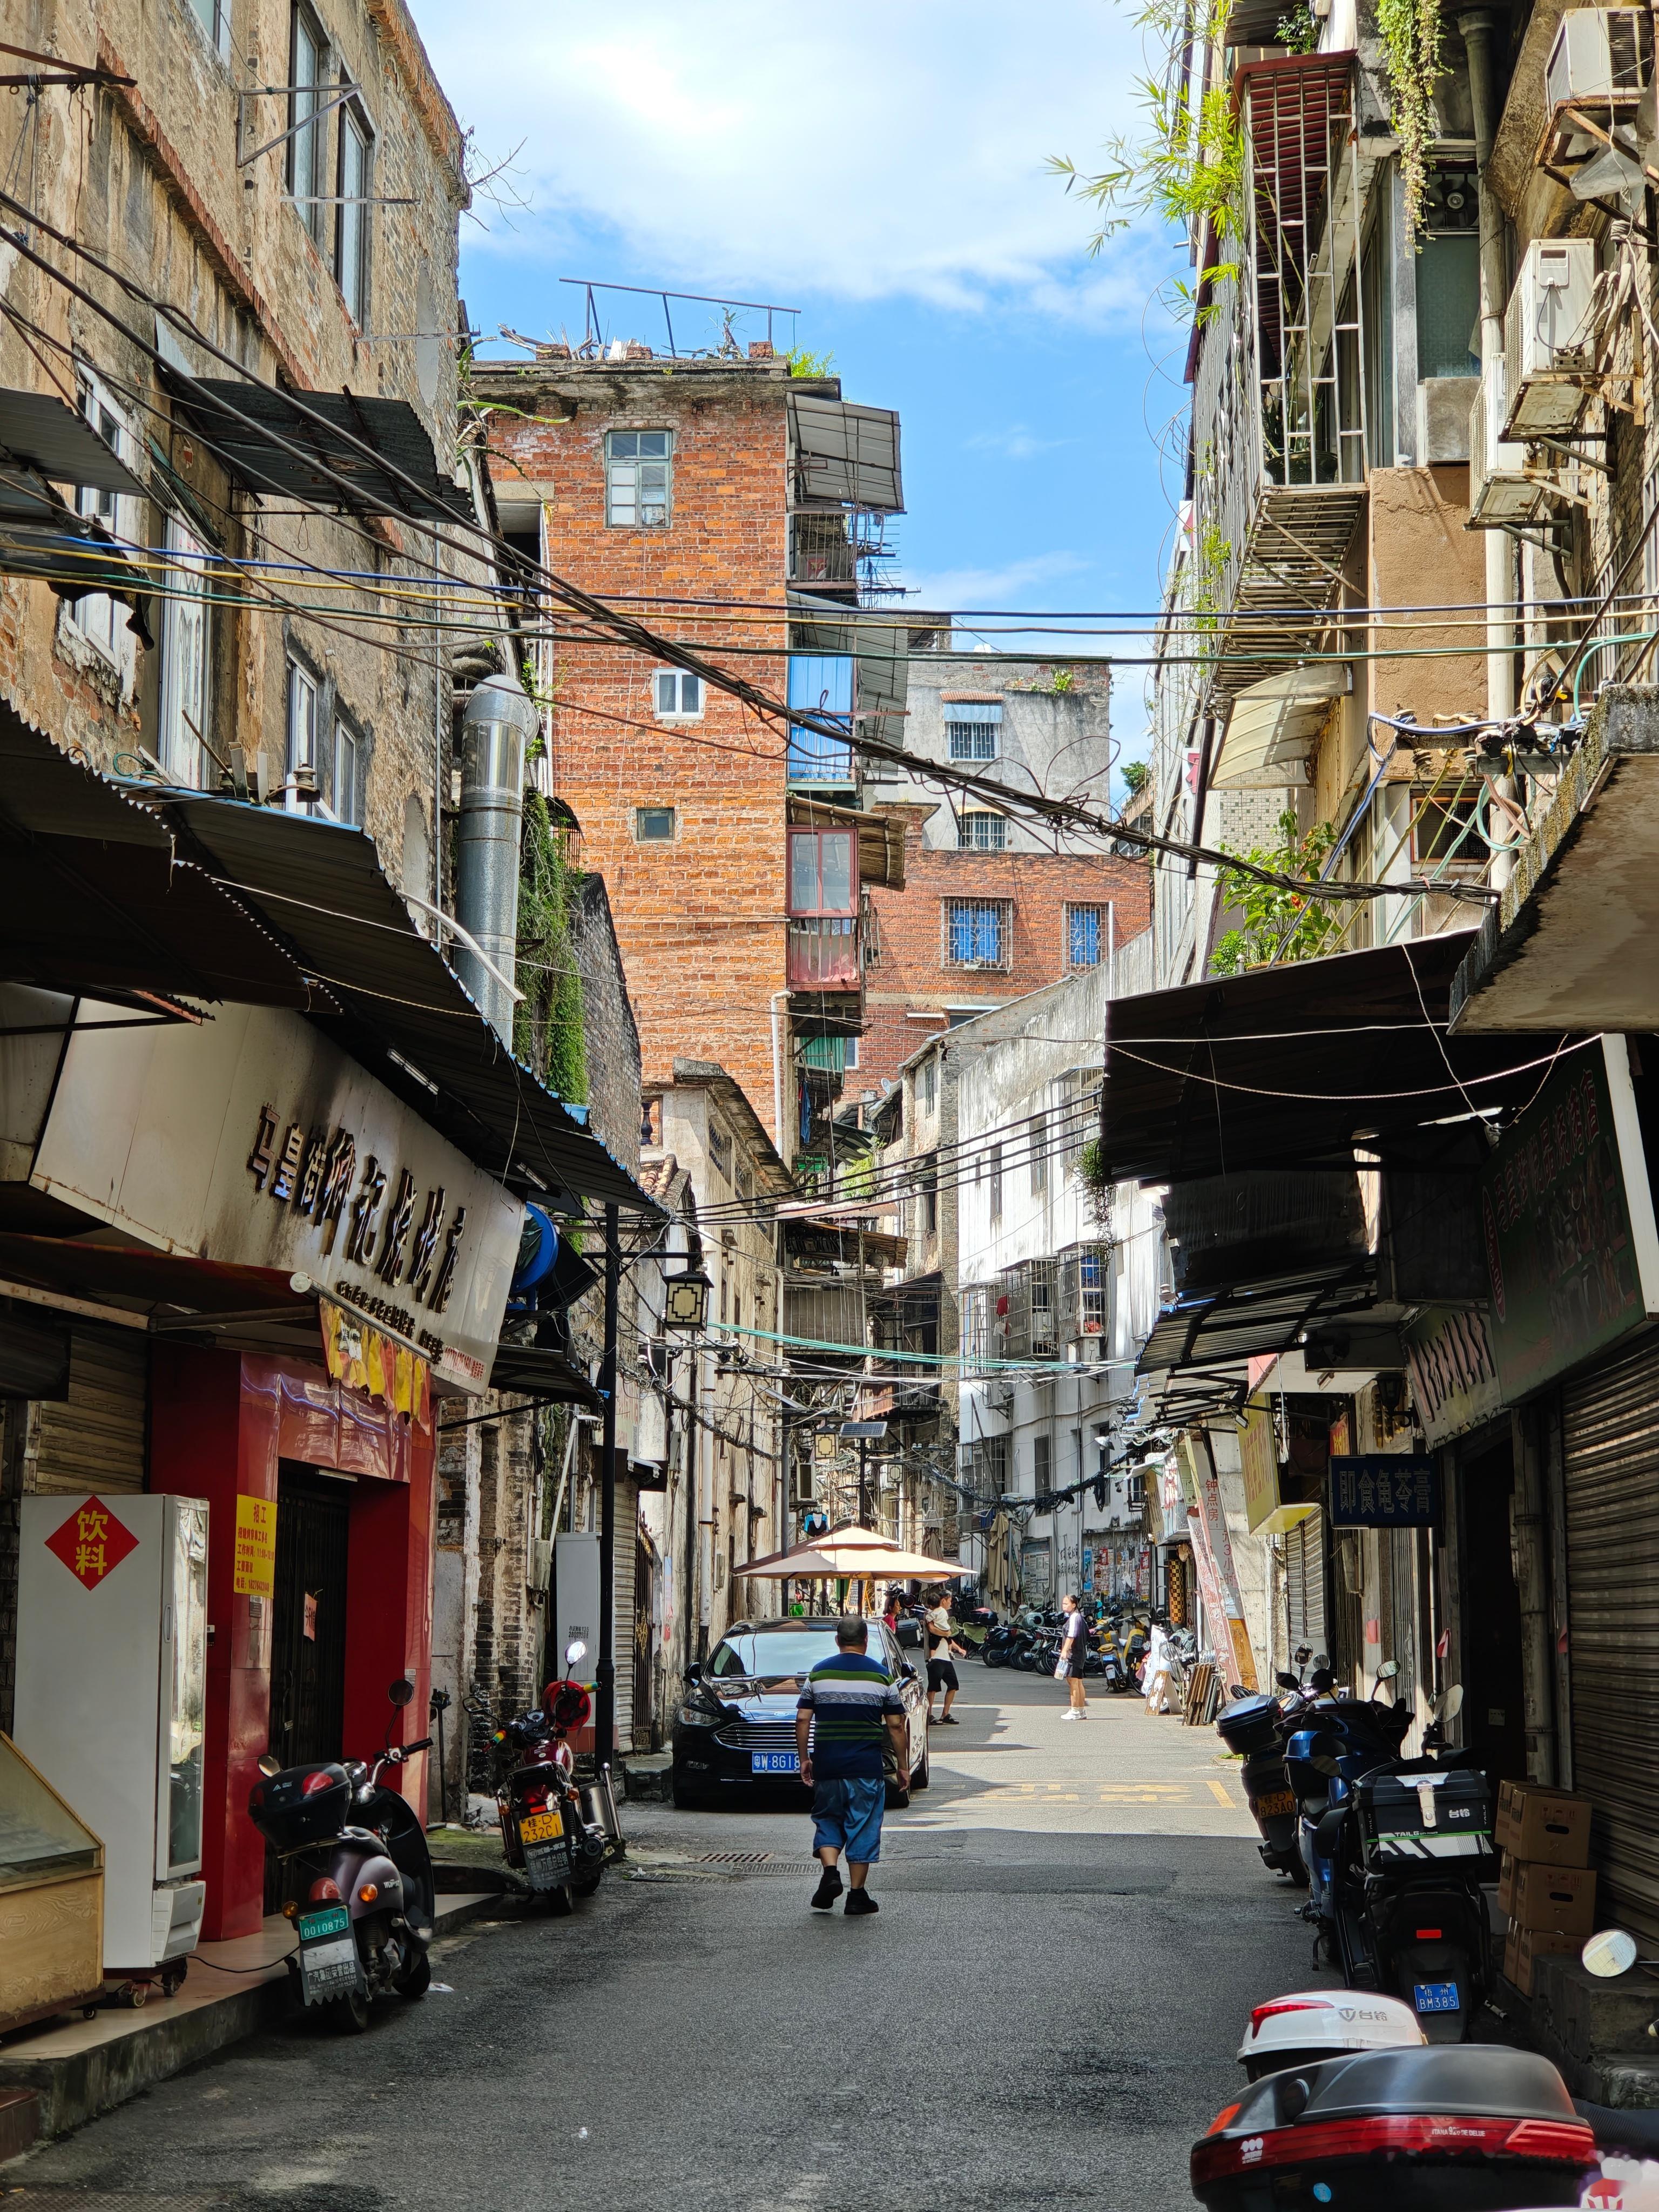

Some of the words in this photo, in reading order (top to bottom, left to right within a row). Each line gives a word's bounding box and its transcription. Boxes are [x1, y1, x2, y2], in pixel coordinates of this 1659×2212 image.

[1339, 1467, 1431, 1514] 即食龟苓膏
[253, 1502, 266, 1524] 招工
[76, 1510, 108, 1576] 饮料
[754, 1755, 801, 1769] 粤W·8G18
[1448, 1808, 1471, 1819] 台铃
[304, 1918, 345, 1937] 0010875
[1420, 1996, 1455, 2009] BM385
[1359, 2010, 1388, 2022] 台铃
